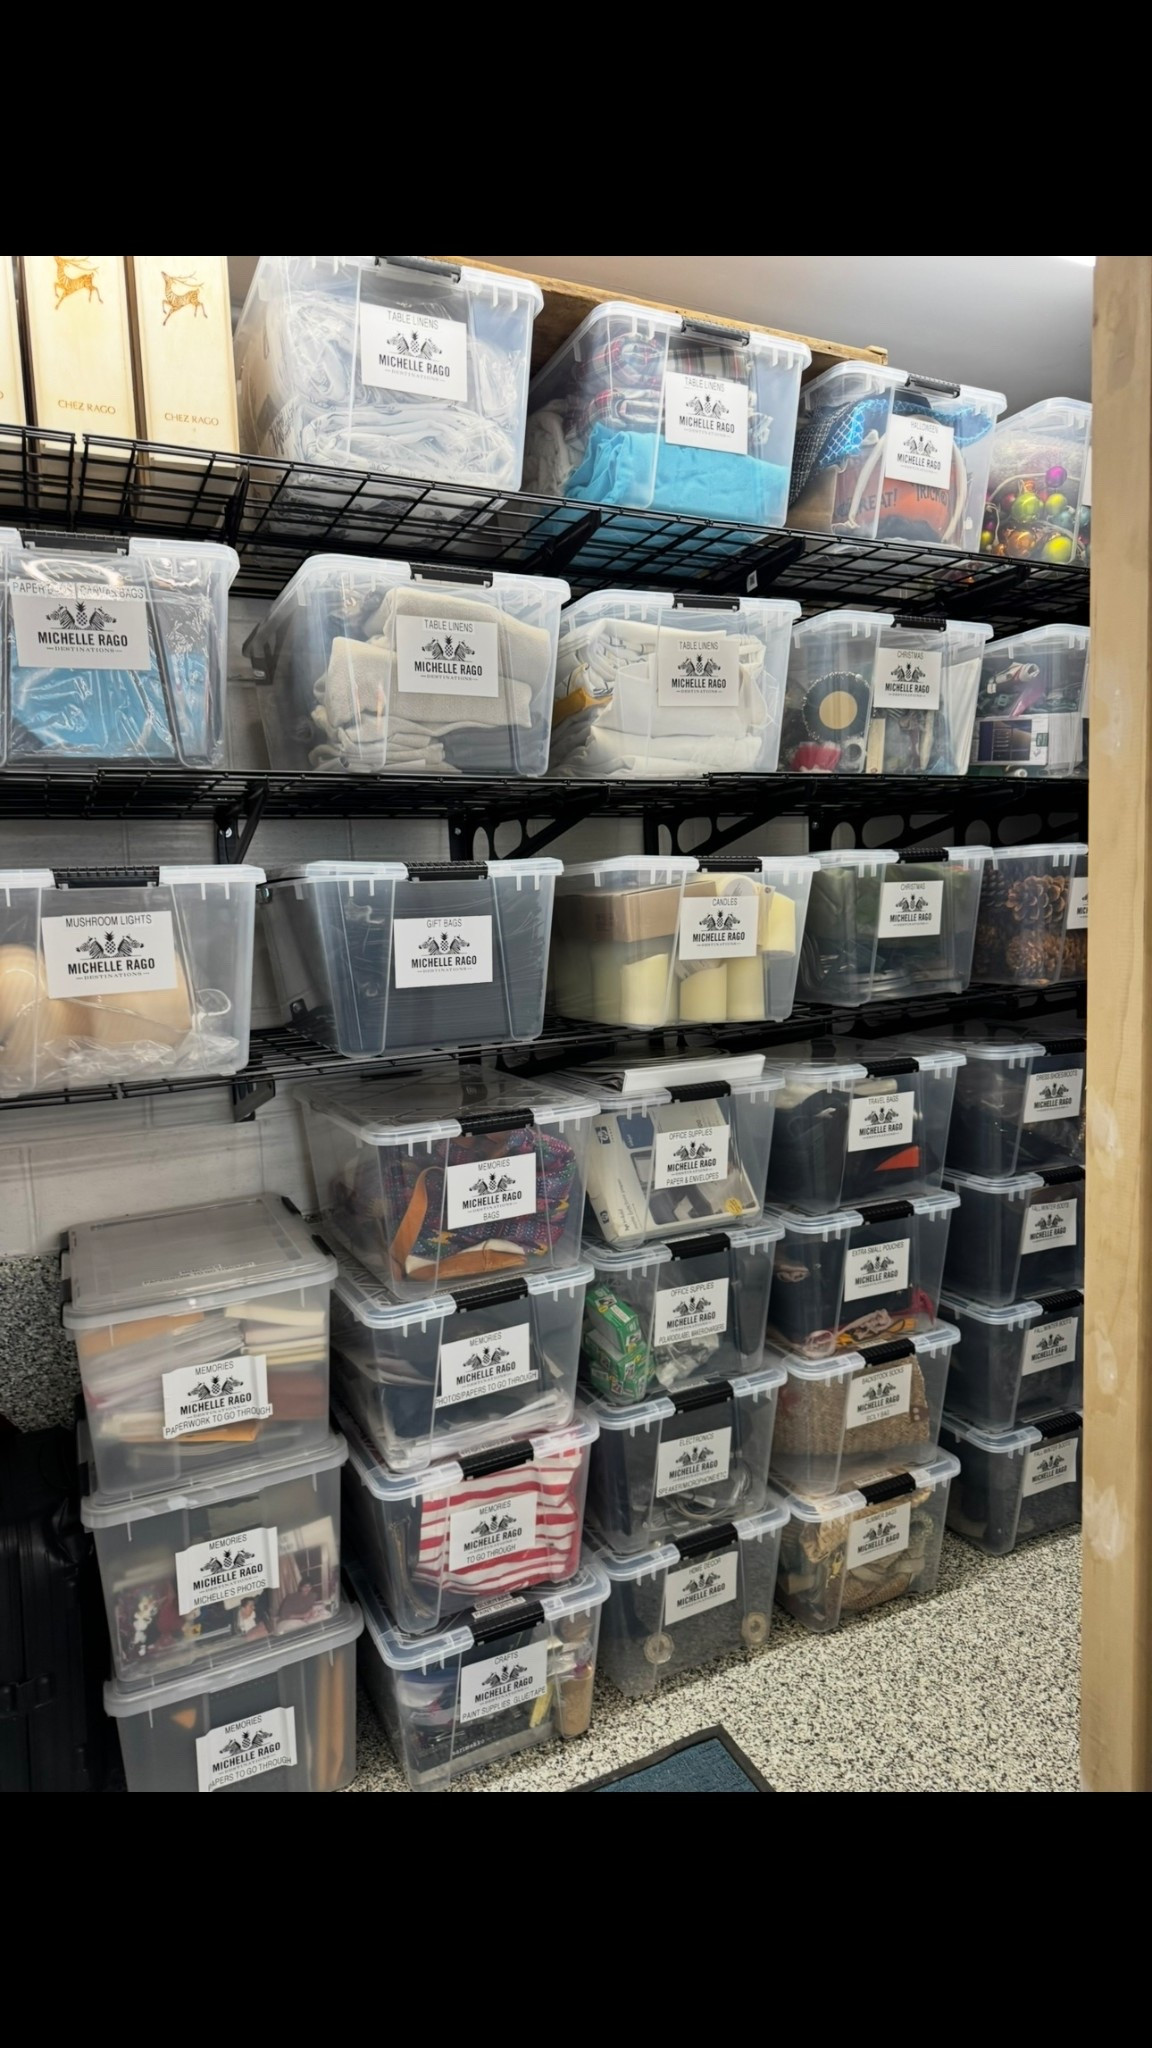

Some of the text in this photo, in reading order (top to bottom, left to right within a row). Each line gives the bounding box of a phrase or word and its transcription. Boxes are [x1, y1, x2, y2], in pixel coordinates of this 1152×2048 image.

[387, 310, 439, 331] TABLE LINENS
[379, 353, 450, 377] MICHELLE RAGO
[685, 376, 725, 392] TABLE LINENS
[58, 399, 116, 415] CHEZ RAGO
[164, 412, 219, 426] CHEZ RAGO
[679, 416, 735, 433] MICHELLE RAGO
[897, 453, 925, 468] MICHELLE
[926, 460, 942, 471] RAGO
[13, 581, 45, 594] PAPER
[119, 588, 144, 599] BAGS
[425, 619, 474, 633] TABLE LINENS
[38, 631, 128, 647] MICHELLE RAGO
[679, 641, 719, 650] TABLE LINENS
[55, 646, 115, 654] DESTINATIONS
[897, 650, 924, 660] CHRISTMAS
[414, 660, 483, 676] MICHELLE RAGO
[671, 678, 727, 689] MICHELLE RAGO
[885, 682, 930, 694] MICHELLE RAGO
[900, 883, 926, 891] CHRISTMAS
[712, 898, 738, 906] CANDLES
[65, 914, 152, 928] MUSHROOM LIGHTS
[426, 918, 462, 929] GIFT BAGS
[889, 912, 932, 923] MICHELLE RAGO
[692, 931, 746, 943] MICHELLE RAGO
[68, 957, 156, 975] MICHELLE RAGO
[411, 954, 478, 969] MICHELLE RAGO
[84, 970, 142, 980] DESTINATIONS
[868, 1095, 899, 1105] TRAVEL BAGS
[1034, 1098, 1058, 1109] MICHELLE
[1059, 1097, 1073, 1105] RAGO
[669, 1128, 713, 1140] OFFICE SUPPLIES
[859, 1125, 887, 1136] MICHELLE
[887, 1122, 903, 1132] RAGO
[478, 1158, 510, 1171] MEMORIES
[667, 1160, 699, 1172] MICHELLE
[699, 1158, 717, 1168] RAGO
[666, 1177, 684, 1186] PAPER
[689, 1172, 719, 1183] ENVELOPES
[462, 1191, 523, 1209] MICHELLE RAGO
[483, 1211, 500, 1221] BAGS
[1030, 1229, 1053, 1240] MICHELLE
[1053, 1226, 1067, 1235] RAGO
[852, 1241, 905, 1257] EXTRA SMALL POUCHES
[855, 1272, 883, 1285] MICHELLE
[883, 1269, 899, 1280] RAGO
[670, 1282, 714, 1297] OFFICE SUPPLIES
[666, 1315, 697, 1328] MICHELLE
[699, 1311, 716, 1322] RAGO
[469, 1332, 502, 1347] MEMORIES
[1031, 1350, 1055, 1361] MICHELLE
[1055, 1345, 1068, 1354] RAGO
[195, 1360, 234, 1376] MEMORIES
[456, 1361, 516, 1385] MICHELLE RAGO
[488, 1381, 497, 1391] TO
[498, 1379, 507, 1389] GO
[508, 1371, 537, 1386] THROUGH
[862, 1371, 888, 1385] BACKSTOCK
[180, 1392, 252, 1415] MICHELLE RAGO
[857, 1399, 885, 1412] MICHELLE
[885, 1394, 900, 1405] RAGO
[165, 1405, 271, 1436] PAPERWORK TO GO THROUGH
[679, 1432, 714, 1447] ELECTRONICS
[669, 1465, 700, 1479] MICHELLE
[701, 1460, 718, 1471] RAGO
[1032, 1470, 1054, 1482] MICHELLE
[1055, 1465, 1068, 1475] RAGO
[479, 1500, 511, 1515] MEMORIES
[885, 1510, 897, 1518] BAGS
[209, 1534, 247, 1551] MEMORIES
[464, 1527, 523, 1552] MICHELLE RAGO
[857, 1540, 884, 1553] MICHELLE
[885, 1533, 900, 1544] RAGO
[467, 1545, 516, 1564] TO GO THROUGH
[193, 1563, 263, 1591] MICHELLE RAGO
[689, 1565, 703, 1575] HOME
[194, 1579, 266, 1606] MICHELLE'S PHOTOS
[677, 1590, 707, 1607] MICHELLE
[709, 1582, 726, 1595] RAGO
[474, 1606, 492, 1618] PAINT
[494, 1651, 519, 1665] CRAFTS
[475, 1676, 534, 1703] MICHELLE RAGO
[462, 1686, 546, 1720] PAINT SUPPLIES GLUE/TAPE
[225, 1715, 262, 1734] MEMORIES
[212, 1741, 281, 1773] MICHELLE RAGO
[235, 1756, 291, 1779] TO GO THROUGH
